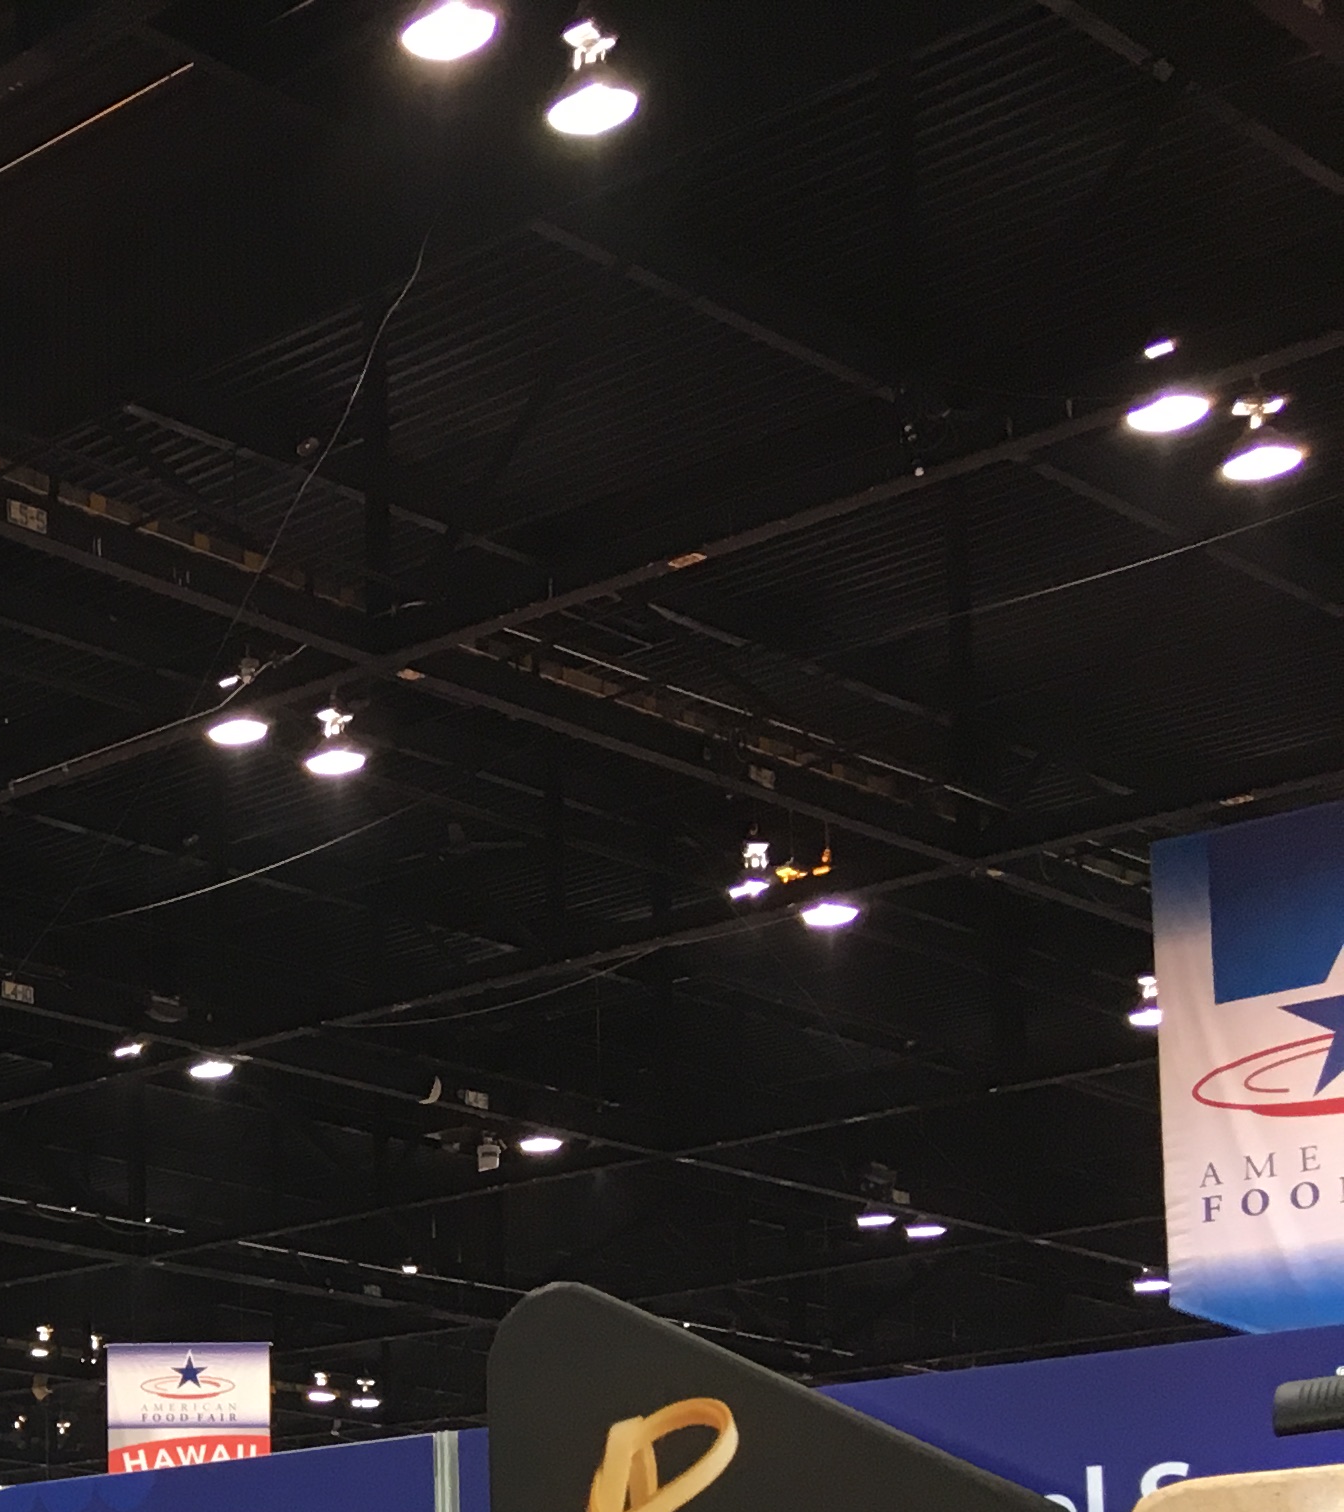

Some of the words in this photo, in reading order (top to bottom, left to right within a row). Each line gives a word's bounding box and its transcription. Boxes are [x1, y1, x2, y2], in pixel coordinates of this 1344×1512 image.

[140, 1403, 238, 1413] AMERICAN
[141, 1412, 189, 1423] FOOD
[198, 1412, 238, 1423] FAIR
